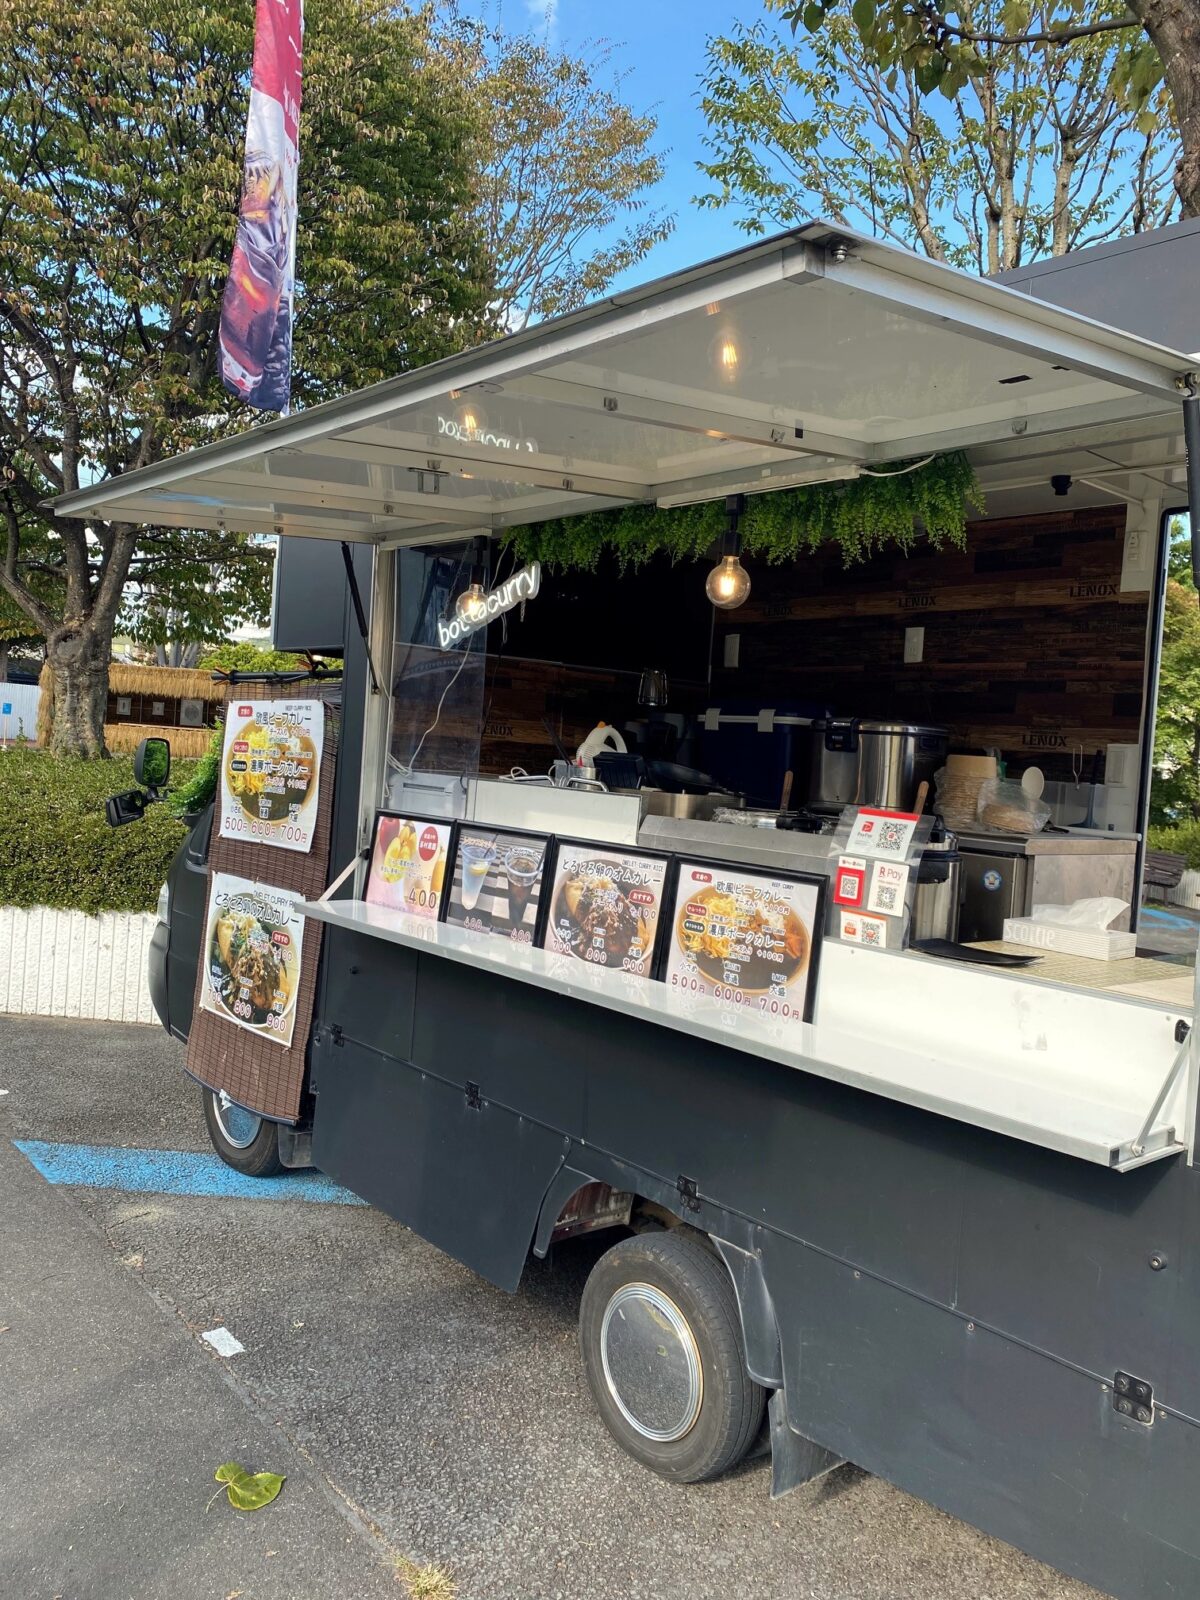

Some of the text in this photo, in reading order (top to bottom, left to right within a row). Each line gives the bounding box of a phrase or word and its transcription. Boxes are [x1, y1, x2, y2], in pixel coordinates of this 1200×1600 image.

[1069, 583, 1119, 598] LENOX
[438, 565, 536, 648] bottacurry
[897, 595, 937, 608] LENOX
[481, 724, 514, 737] ENOX
[1022, 734, 1070, 748] LENOX
[562, 858, 661, 886] とろとろ卵のオムカレー
[409, 887, 437, 909] 400
[716, 881, 792, 901] 欧風ビーフカレー
[708, 923, 785, 948] 濃厚ポークカレー
[586, 948, 607, 964] 800
[757, 949, 784, 962] +100円
[623, 958, 644, 973] 900
[680, 961, 698, 973] 小さめ
[671, 973, 800, 1019] 500円 600円 700円
[769, 984, 786, 997] 大盛
